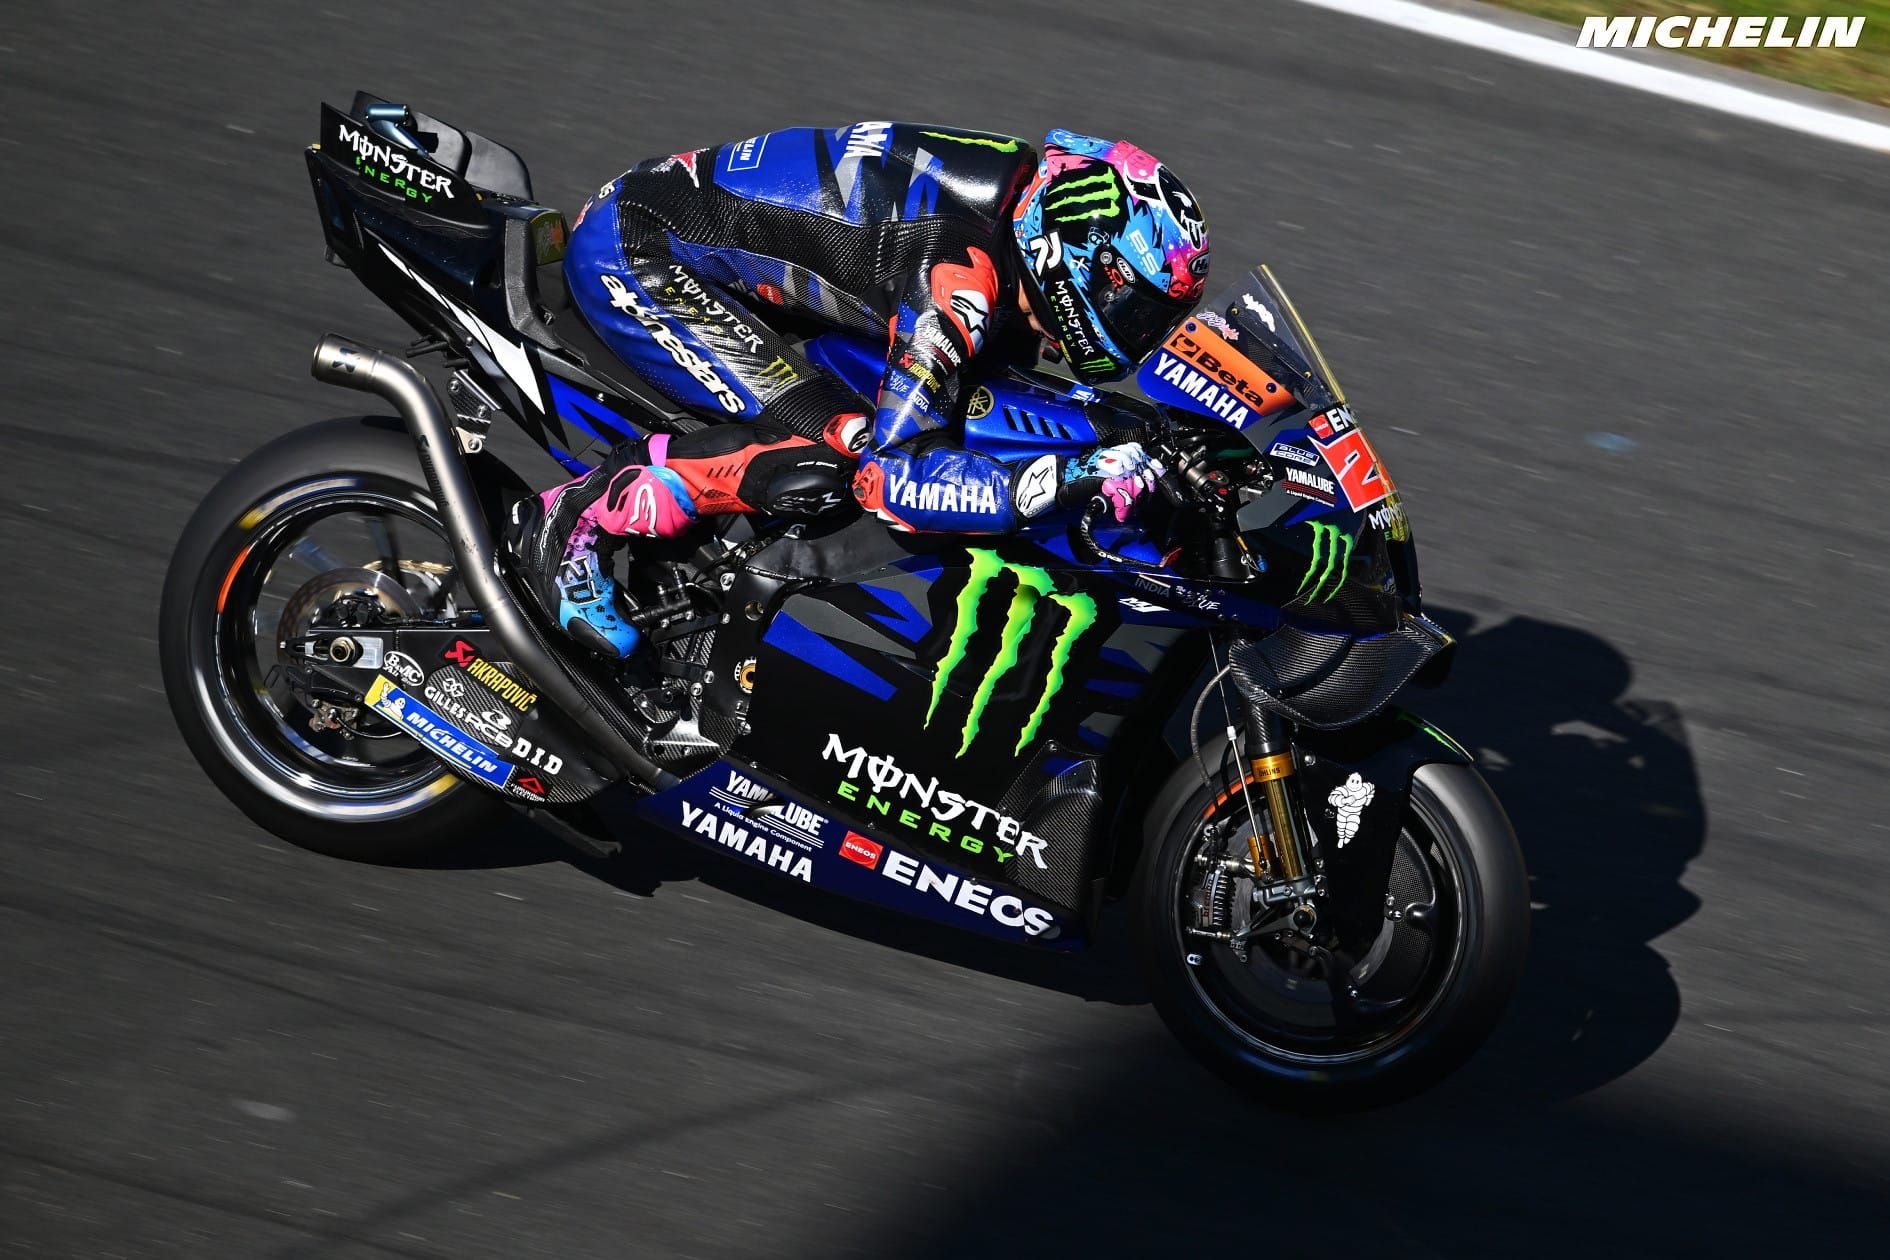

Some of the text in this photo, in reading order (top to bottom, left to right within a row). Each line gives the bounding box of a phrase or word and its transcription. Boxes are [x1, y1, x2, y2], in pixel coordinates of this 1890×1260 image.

[338, 124, 455, 199] MONSTER
[356, 156, 433, 203] ENERGY
[669, 264, 764, 354] MONSTER
[1050, 295, 1077, 348] ENERGY
[1055, 280, 1095, 356] MONSTER
[600, 274, 746, 414] alpinestars
[1153, 352, 1249, 430] YAMAHA
[1196, 351, 1264, 408] Beta
[890, 474, 997, 514] YAMAHA
[1285, 466, 1335, 495] YAMALUBE
[1134, 577, 1171, 598] INDIA
[386, 653, 422, 683] BMC
[424, 686, 467, 719] GILLES
[465, 714, 513, 750] RCB
[406, 711, 498, 774] MICHELIN
[511, 737, 564, 775] D.I.D
[714, 801, 813, 852] A Liquid Engine Component
[726, 770, 825, 836] YAMLUBE
[822, 733, 1049, 870] MONSTER
[837, 780, 1015, 864] ENERGY
[681, 800, 813, 883] YAMAHA
[845, 840, 1054, 936] ENEOS ENEOS
